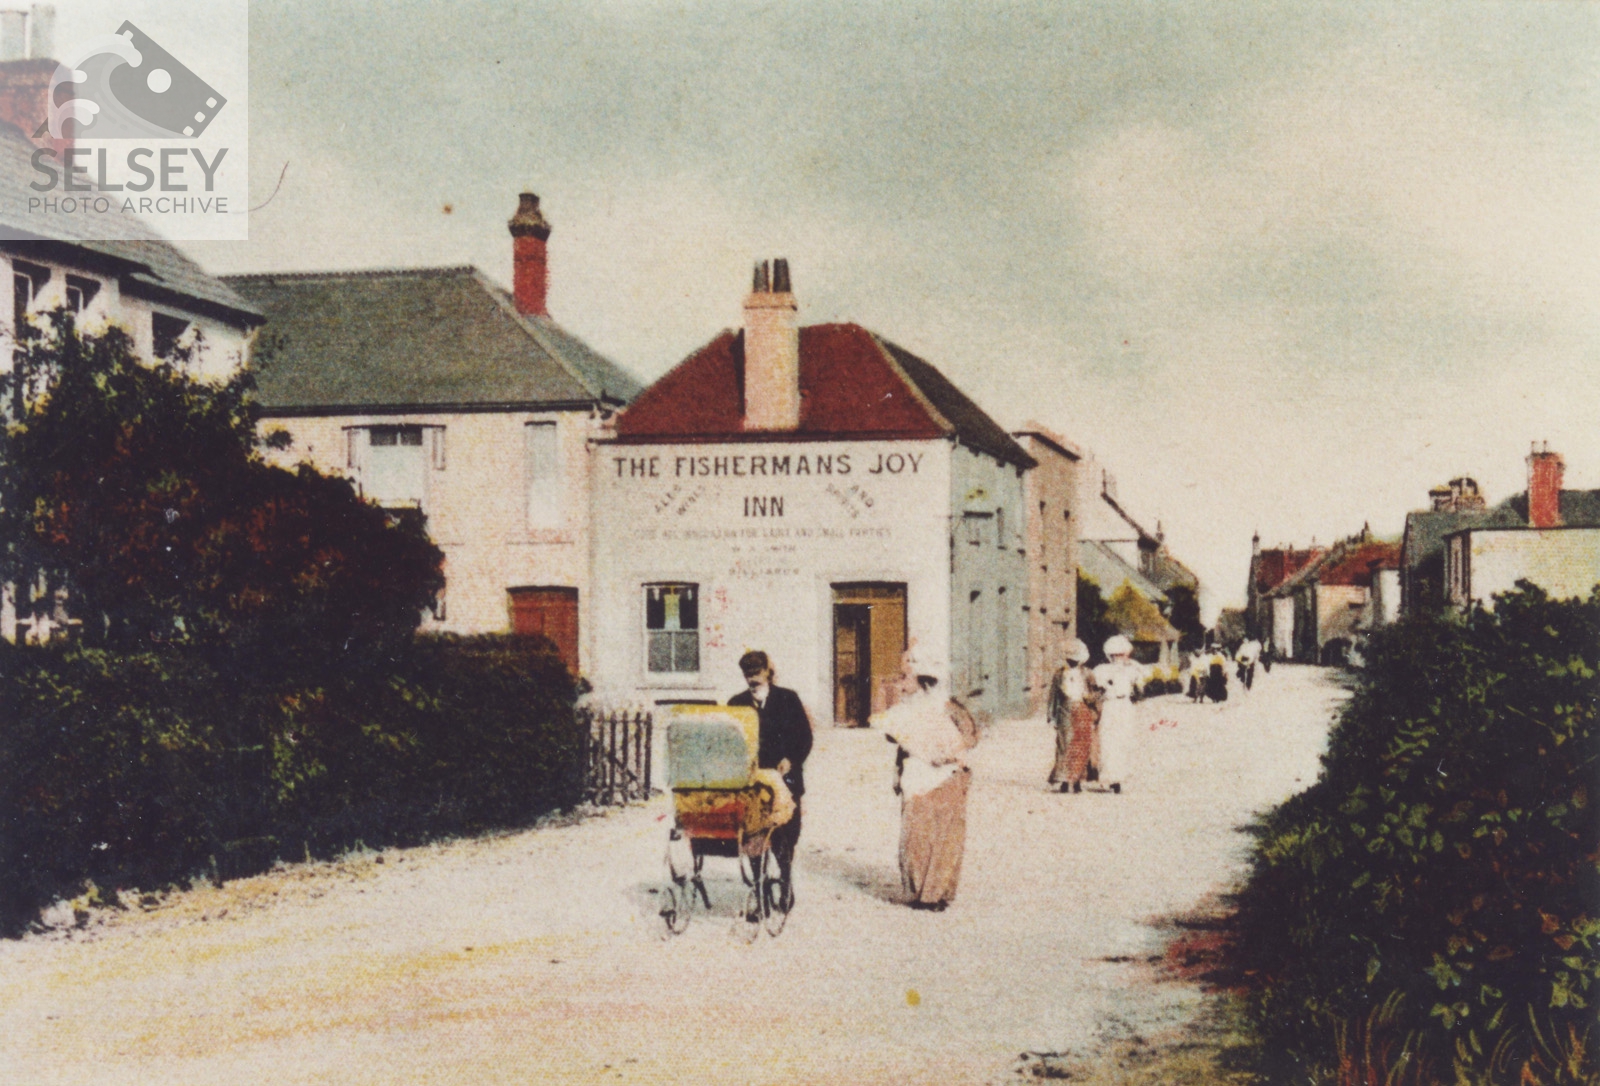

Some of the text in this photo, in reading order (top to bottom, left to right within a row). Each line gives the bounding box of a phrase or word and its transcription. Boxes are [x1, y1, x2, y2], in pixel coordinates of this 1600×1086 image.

[613, 453, 924, 478] THE FISHERMANS JOY
[743, 495, 785, 518] INN
